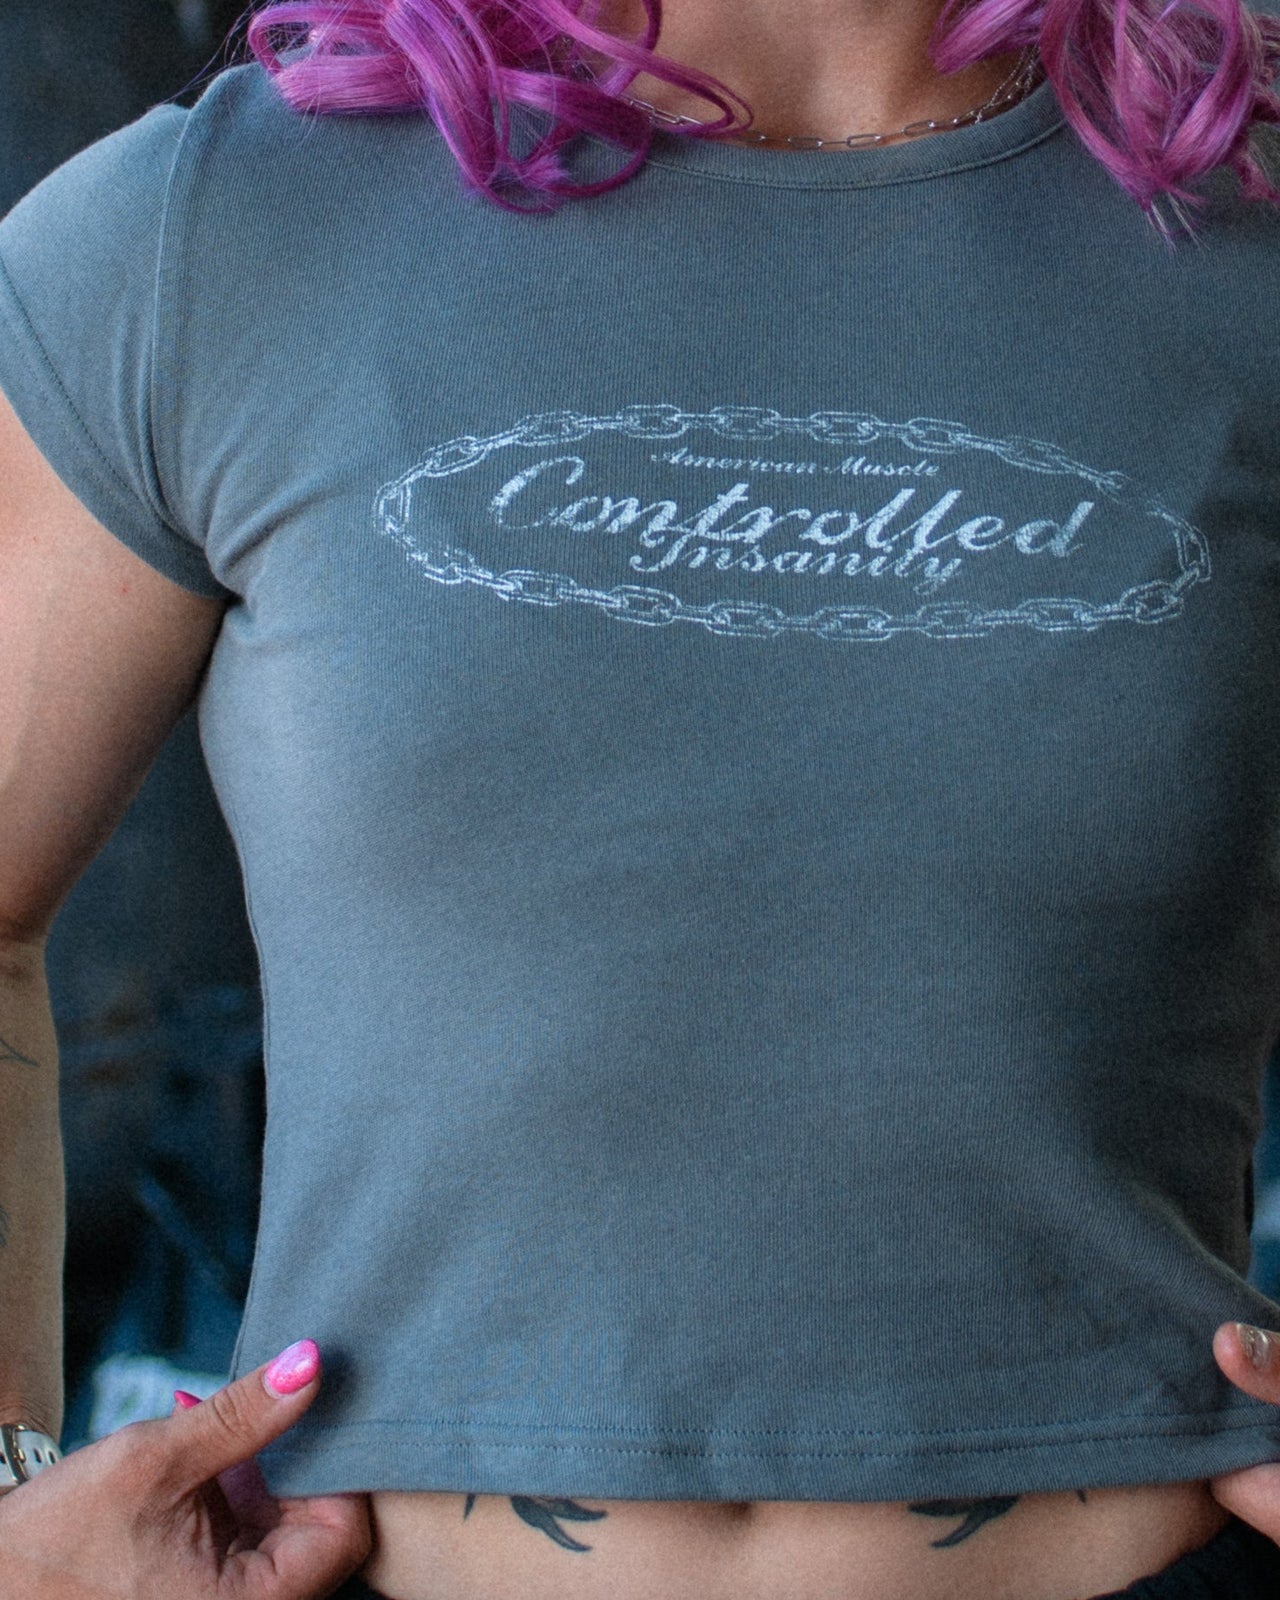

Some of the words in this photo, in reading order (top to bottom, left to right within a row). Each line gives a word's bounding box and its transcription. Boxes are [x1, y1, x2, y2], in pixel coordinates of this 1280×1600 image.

[651, 447, 817, 475] American
[824, 455, 939, 477] Muscle
[488, 455, 1095, 558] Controlled
[629, 529, 962, 596] Insanity
